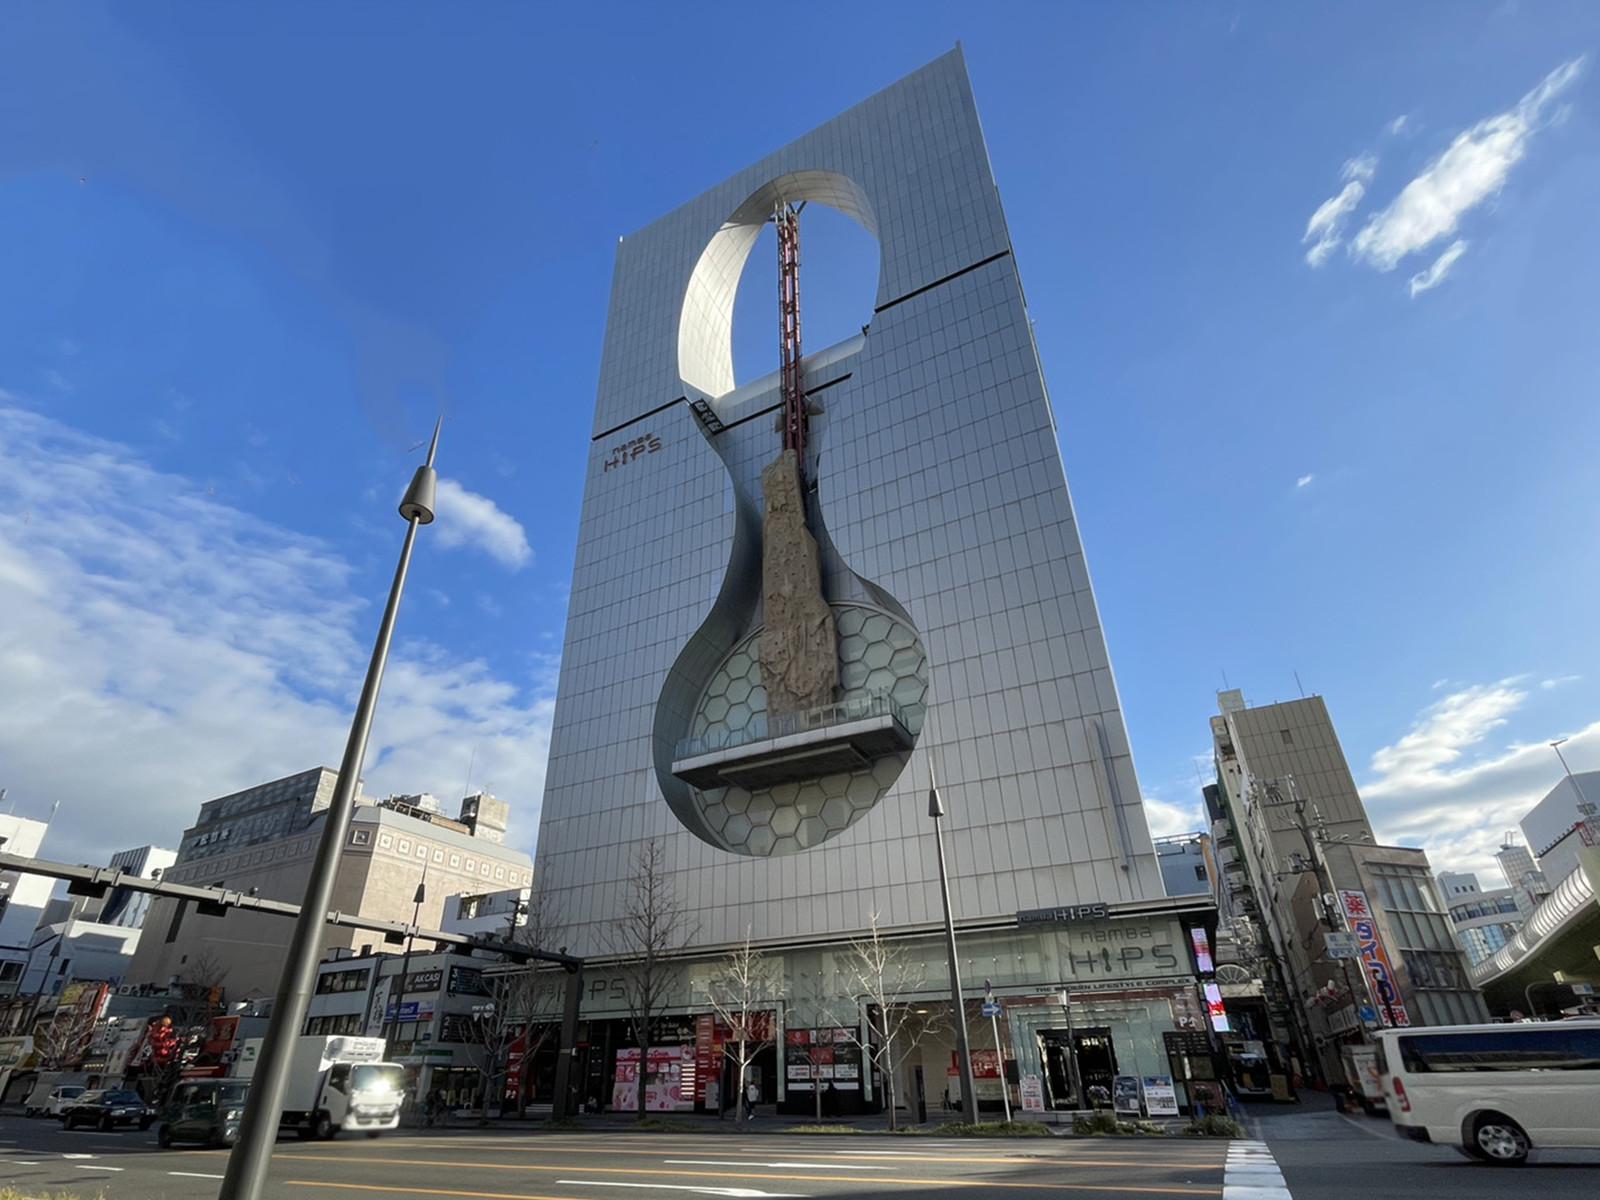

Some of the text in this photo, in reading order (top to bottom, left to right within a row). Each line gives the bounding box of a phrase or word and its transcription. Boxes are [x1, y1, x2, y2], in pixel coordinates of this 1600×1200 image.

[603, 437, 662, 473] HIPS
[1343, 890, 1367, 915] 薬
[1053, 907, 1106, 921] HIPS
[1068, 943, 1178, 975] HIPS
[1145, 978, 1191, 986] COMPLEX
[1178, 1016, 1188, 1028] P
